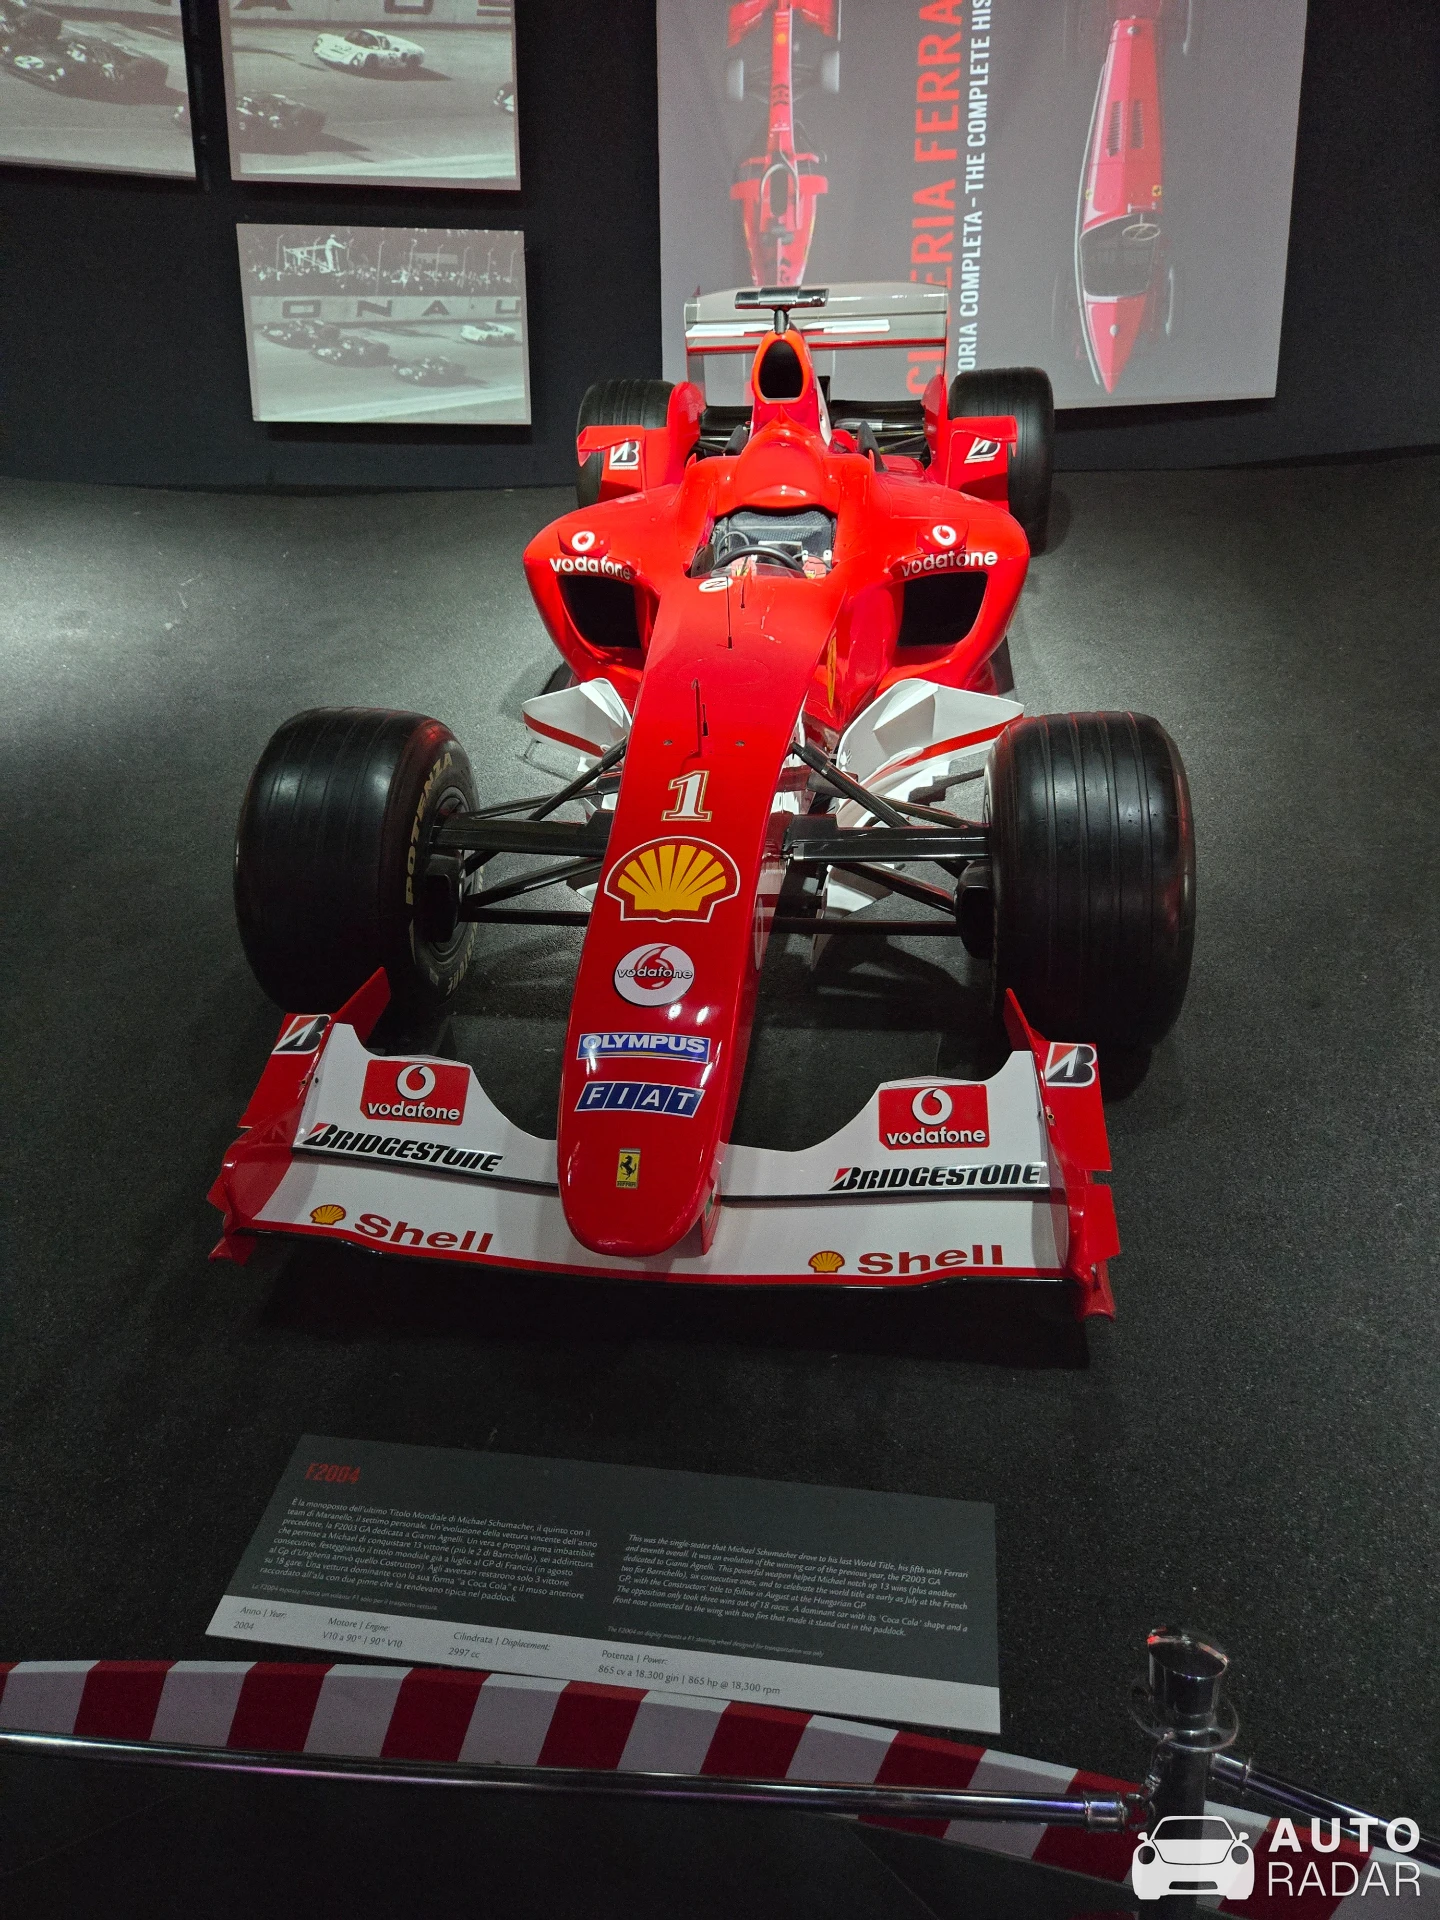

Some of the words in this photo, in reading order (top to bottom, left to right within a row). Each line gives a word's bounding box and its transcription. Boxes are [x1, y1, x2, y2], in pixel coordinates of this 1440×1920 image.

[967, 37, 990, 147] COMPLETE
[965, 152, 986, 194] THE
[960, 211, 983, 317] COMPLETA
[957, 323, 977, 374] ORIA
[549, 557, 631, 581] vodafone
[902, 549, 998, 576] vodafone
[660, 770, 713, 822] 1
[617, 965, 693, 980] vodafone
[582, 1034, 706, 1053] OLYMPUS
[368, 1101, 460, 1121] vodafone
[586, 1087, 696, 1111] FIAT
[303, 1123, 504, 1172] BRIDGESTONE
[886, 1126, 986, 1146] vodafone
[828, 1162, 1041, 1191] BRIDGESTONE
[354, 1212, 494, 1253] Shell
[858, 1245, 1003, 1275] Shell
[305, 1463, 361, 1484] F2004
[306, 1501, 347, 1510] monoposto
[390, 1508, 410, 1517] Titolo
[412, 1511, 446, 1521] Mondiale
[457, 1516, 487, 1525] Michael
[487, 1519, 534, 1531] Schumacher,
[542, 1526, 568, 1534] quinto
[277, 1526, 291, 1534] che
[291, 1529, 320, 1537] permise
[328, 1532, 358, 1541] Michael
[333, 1522, 357, 1531] F2003
[371, 1527, 403, 1536] dedicata
[553, 1547, 595, 1557] imbattibile
[482, 1528, 500, 1537] della
[502, 1532, 528, 1540] vettura
[628, 1534, 642, 1542] This
[669, 1539, 710, 1549] single-seater
[711, 1543, 726, 1551] that
[727, 1545, 755, 1554] Michael
[756, 1548, 797, 1558] Schumacher
[798, 1552, 817, 1561] drove
[838, 1557, 852, 1565] last
[853, 1558, 876, 1567] World
[878, 1561, 895, 1570] Title,
[909, 1564, 924, 1573] fifth
[926, 1567, 942, 1575] with
[943, 1568, 968, 1577] Ferrari
[622, 1554, 656, 1563] dedicated
[718, 1564, 732, 1572] This
[732, 1567, 764, 1576] powerful
[764, 1571, 791, 1579] weapon
[792, 1572, 816, 1582] helped
[817, 1575, 846, 1584] Michael
[927, 1589, 956, 1597] another
[722, 1556, 753, 1564] evolution
[776, 1562, 803, 1572] winning
[837, 1568, 867, 1577] previous
[900, 1574, 926, 1583] F2003
[927, 1577, 940, 1585] GA
[239, 1606, 261, 1615] Anno
[327, 1617, 357, 1627] Motore
[233, 1620, 254, 1629] 2004
[322, 1631, 338, 1640] V10
[387, 1639, 402, 1648] V10
[448, 1647, 470, 1656] 2997
[453, 1632, 492, 1643] Cilindrata
[501, 1637, 549, 1650] Displacement:
[601, 1649, 633, 1660] Potenza
[597, 1664, 614, 1674] 865
[687, 1675, 704, 1685] 865
[706, 1678, 718, 1688] hp
[762, 1687, 780, 1695] rpm
